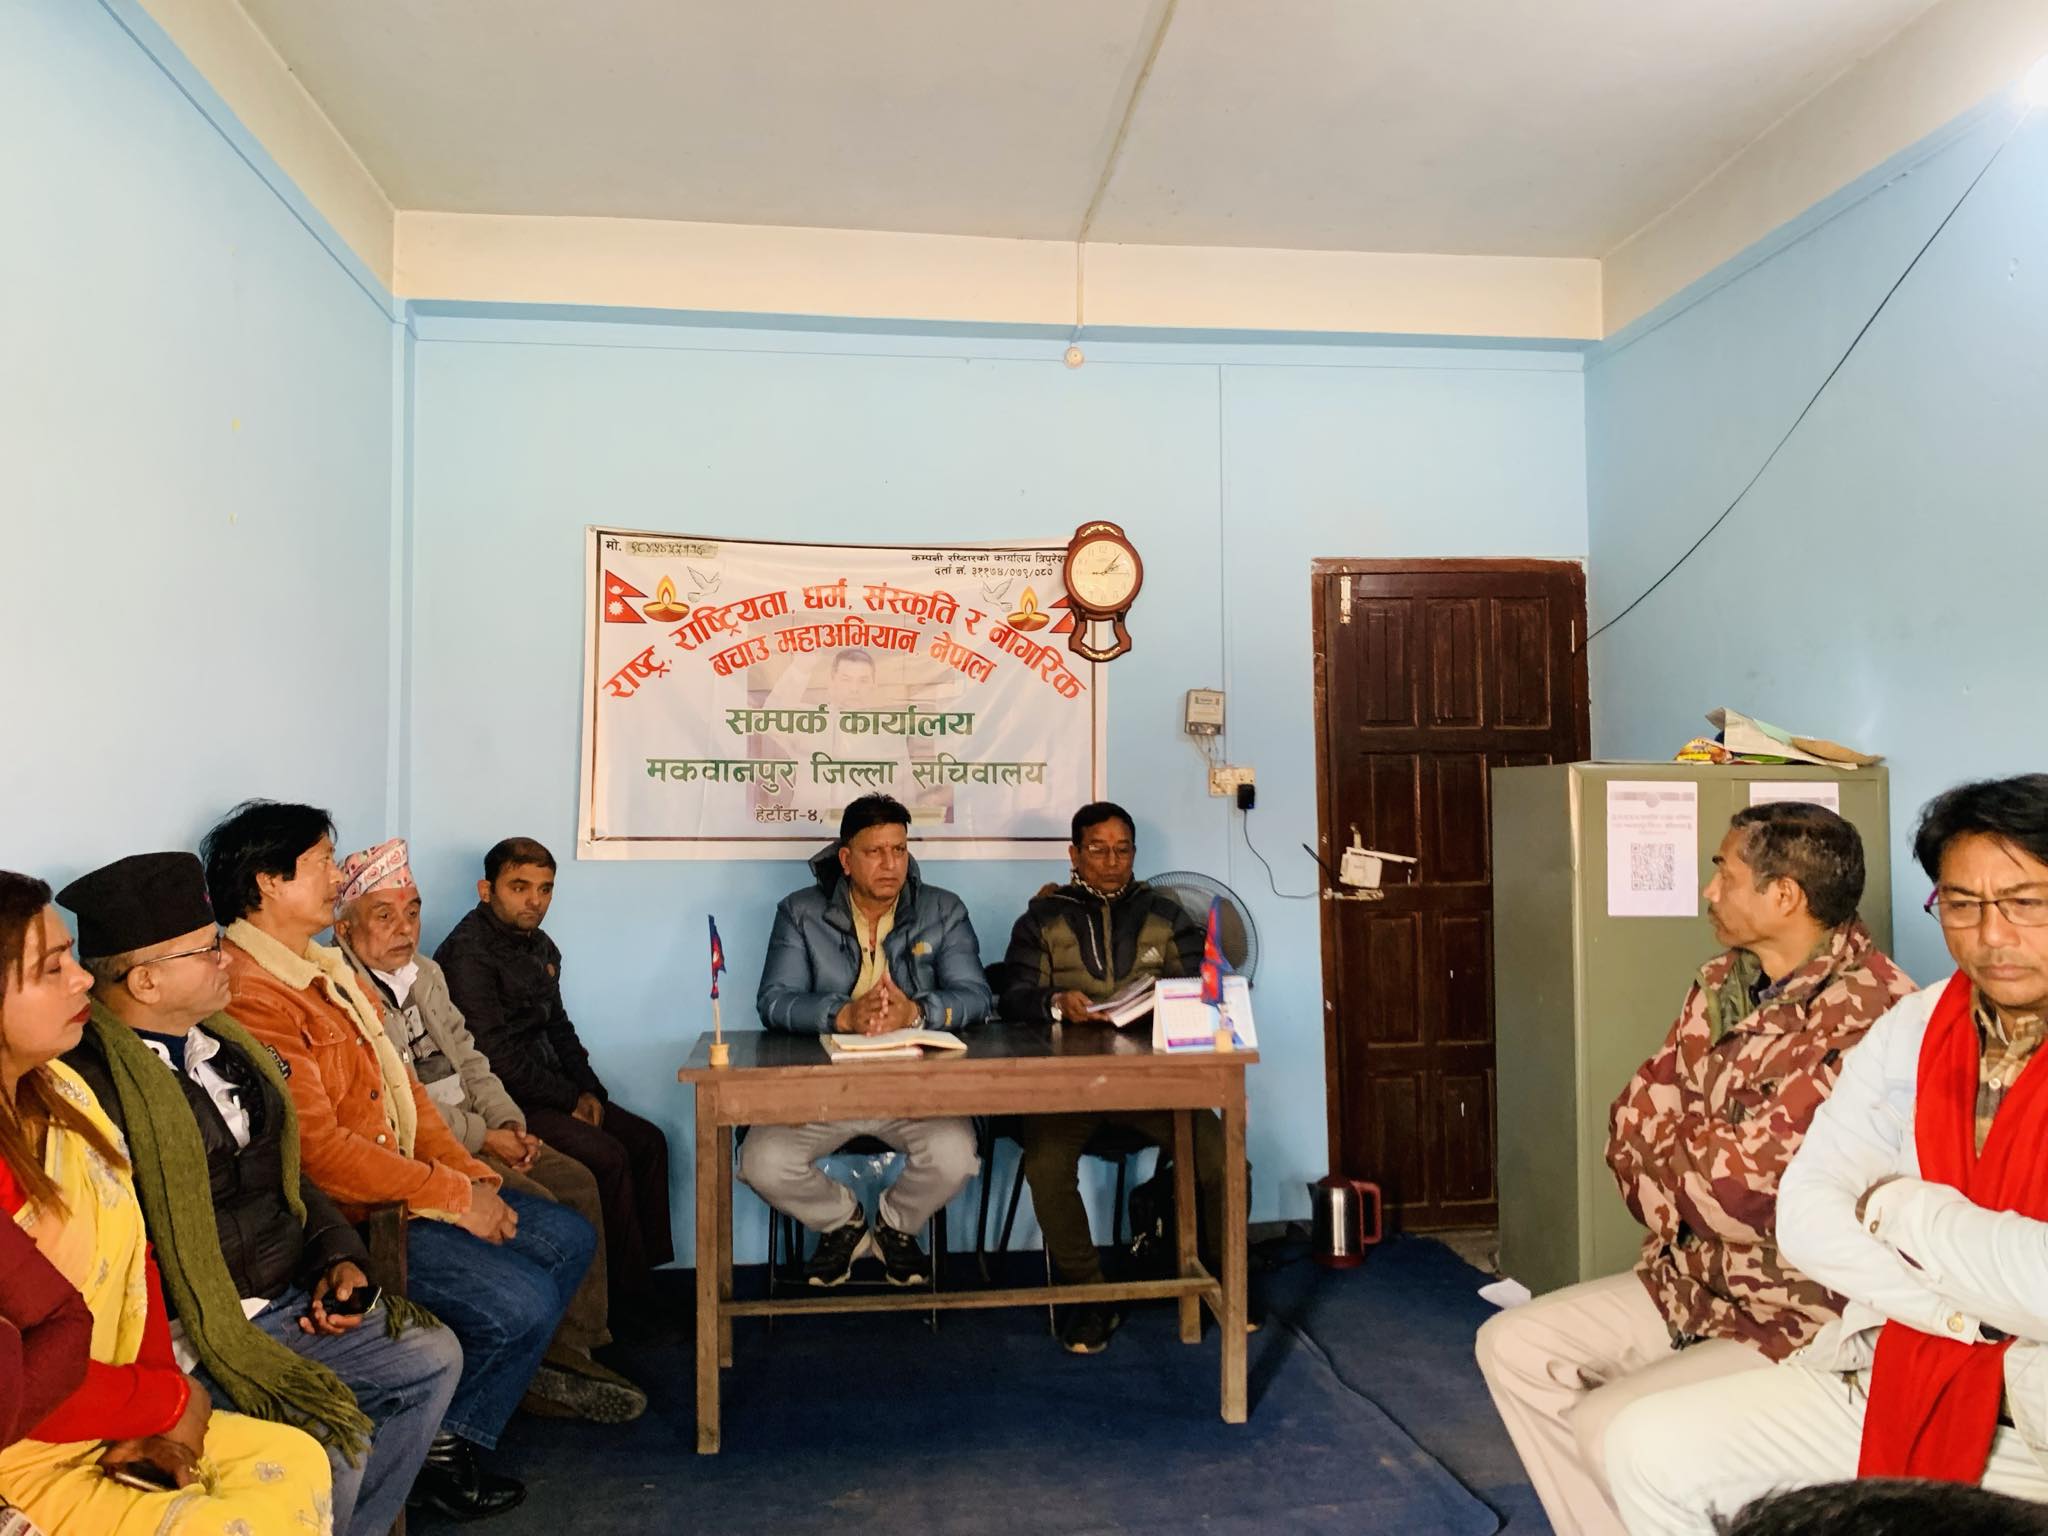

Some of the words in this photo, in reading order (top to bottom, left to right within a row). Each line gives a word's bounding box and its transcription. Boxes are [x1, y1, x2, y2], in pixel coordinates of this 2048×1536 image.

[994, 552, 1032, 563] कार्यालय
[708, 635, 770, 677] बचाउ
[928, 631, 998, 684] नेपाल
[863, 582, 961, 625] संस्कृति
[964, 608, 988, 636] र
[987, 620, 1087, 699] नागरिक
[725, 704, 830, 736] सम्पर्क
[839, 704, 976, 737] कार्यालय
[646, 758, 799, 794] मकवानपुर
[810, 752, 899, 789] जिल्ला
[911, 752, 1048, 790] सचिवालय
